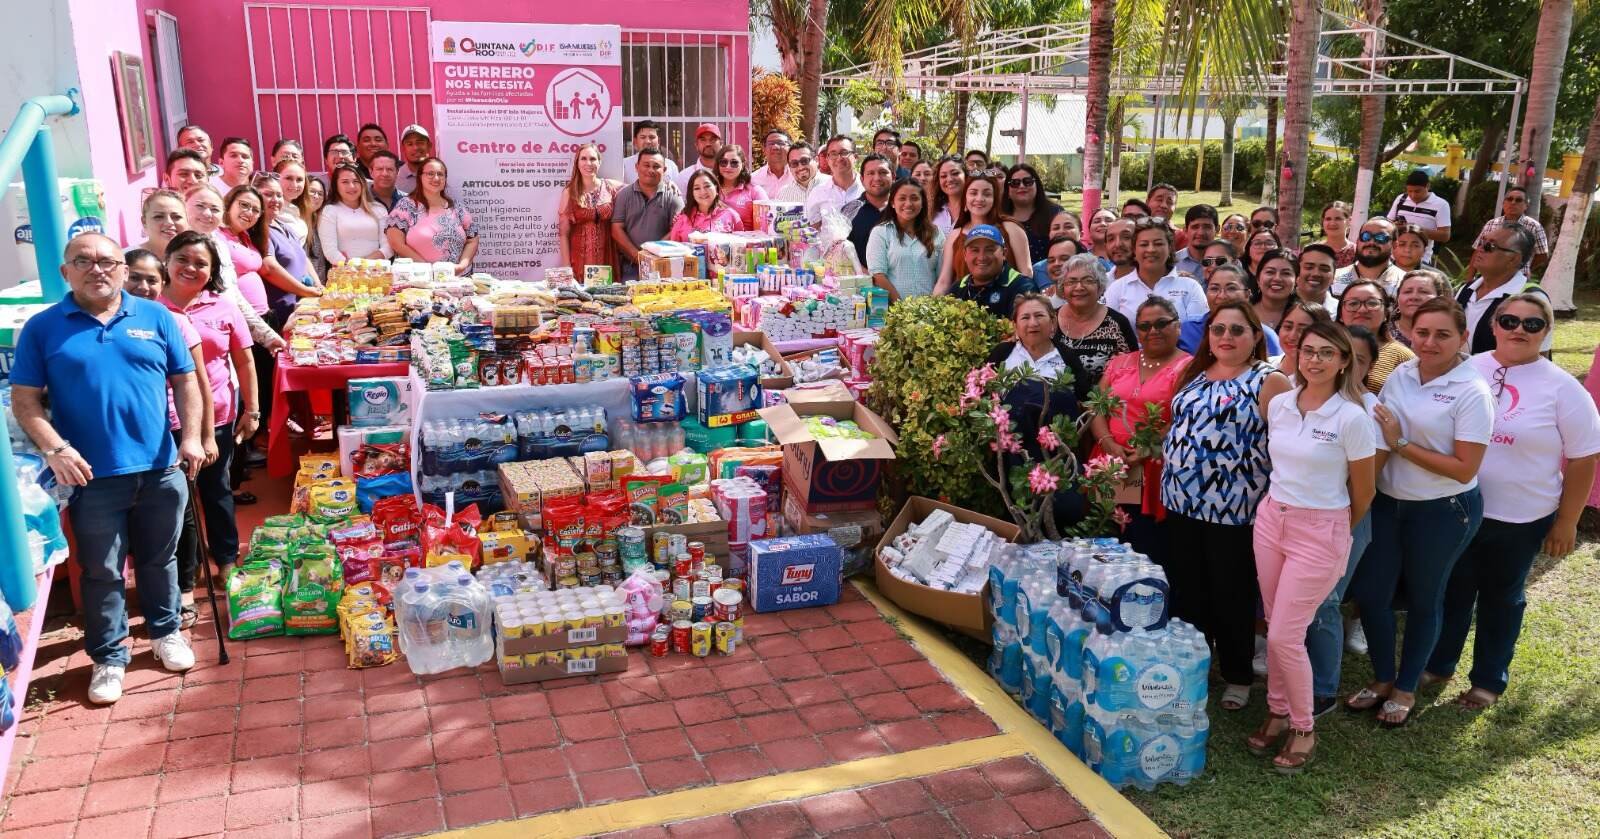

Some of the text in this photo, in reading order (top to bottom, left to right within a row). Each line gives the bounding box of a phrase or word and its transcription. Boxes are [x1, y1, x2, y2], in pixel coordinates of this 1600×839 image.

[460, 37, 516, 53] QUINTANA
[444, 65, 535, 79] GUERRERO
[445, 80, 534, 90] NOS NECESITA
[457, 140, 607, 154] Centro de Acoo
[462, 180, 515, 188] ARTICULOS
[517, 180, 530, 188] DE
[533, 180, 551, 188] USO
[463, 198, 505, 206] Shampoo
[489, 231, 516, 239] limpia
[536, 247, 560, 255] ZAPA
[366, 390, 387, 400] Regio
[786, 567, 812, 580] Tuny
[775, 591, 819, 604] SABOR
